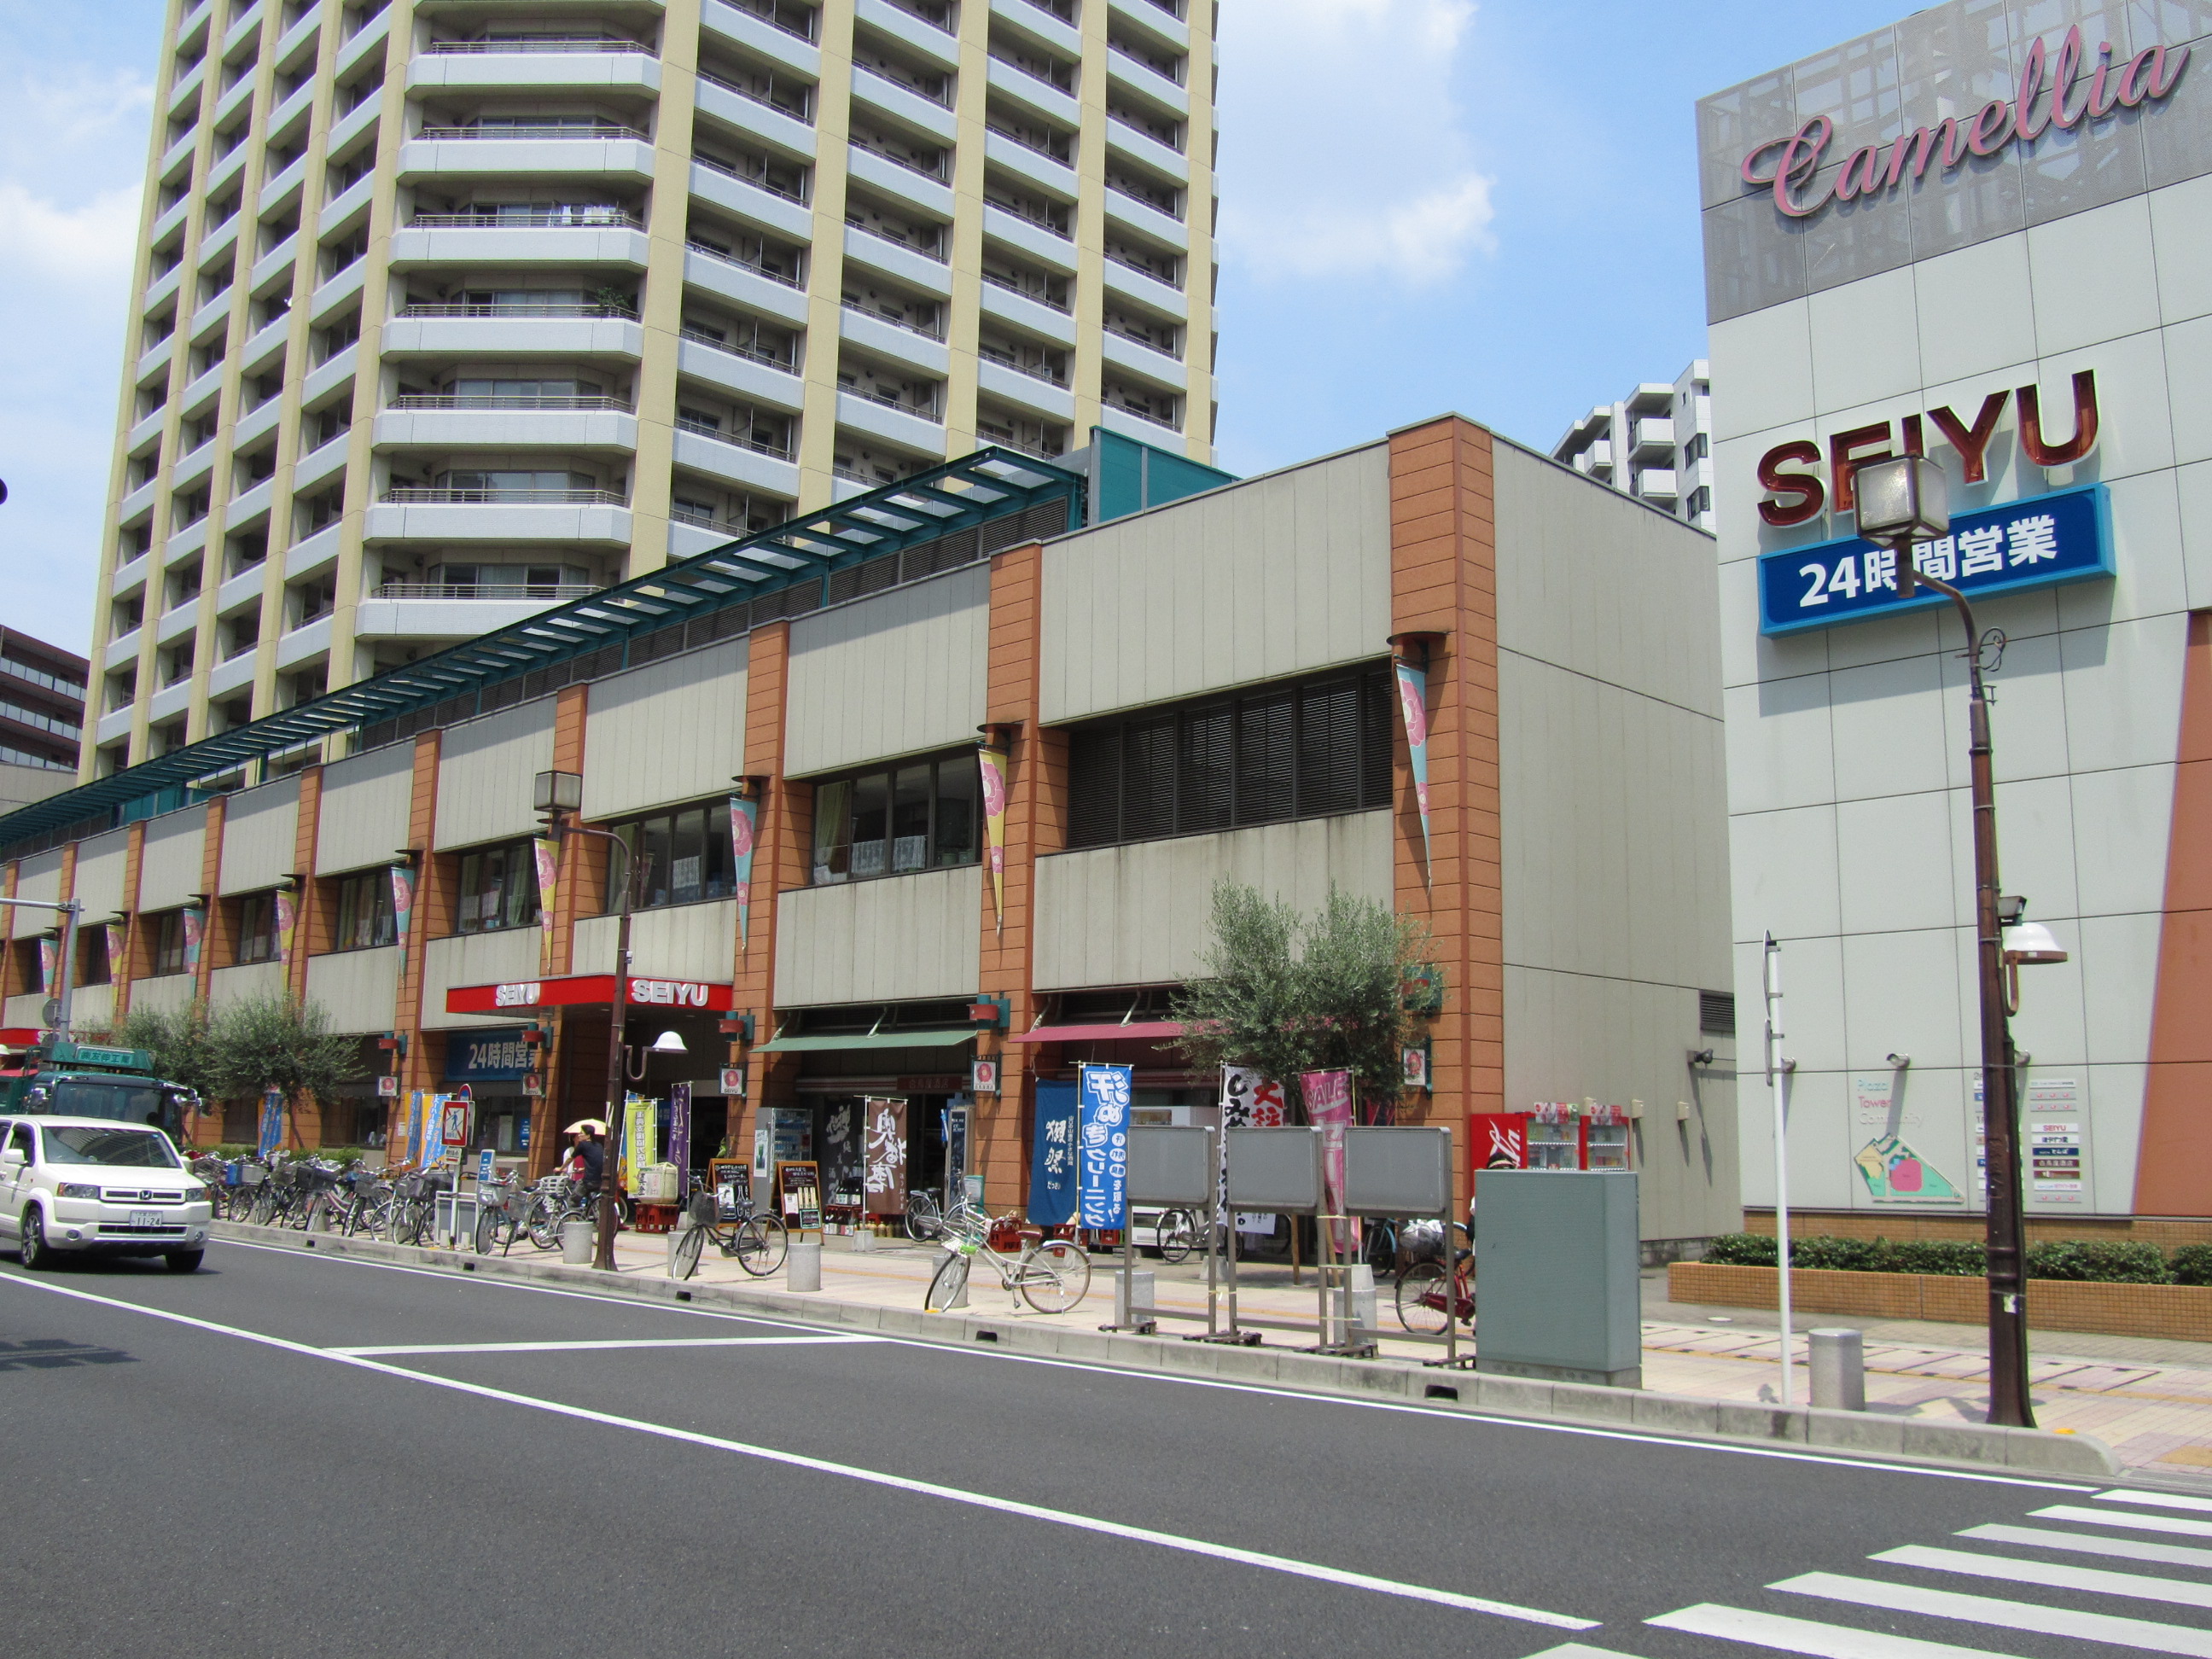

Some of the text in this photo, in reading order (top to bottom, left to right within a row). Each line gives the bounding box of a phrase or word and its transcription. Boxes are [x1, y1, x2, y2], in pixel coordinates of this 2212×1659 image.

[1741, 23, 2191, 217] Camellia
[1757, 370, 2100, 527] SEIYU
[496, 982, 541, 1007] SEIYU
[632, 980, 709, 1007] SEIYU
[1305, 1075, 1348, 1107] SALE
[1857, 1078, 1889, 1091] Plaza
[1858, 1095, 1893, 1108] Tower
[1045, 1119, 1067, 1174] 獺祭
[137, 1217, 160, 1227] 11-24
